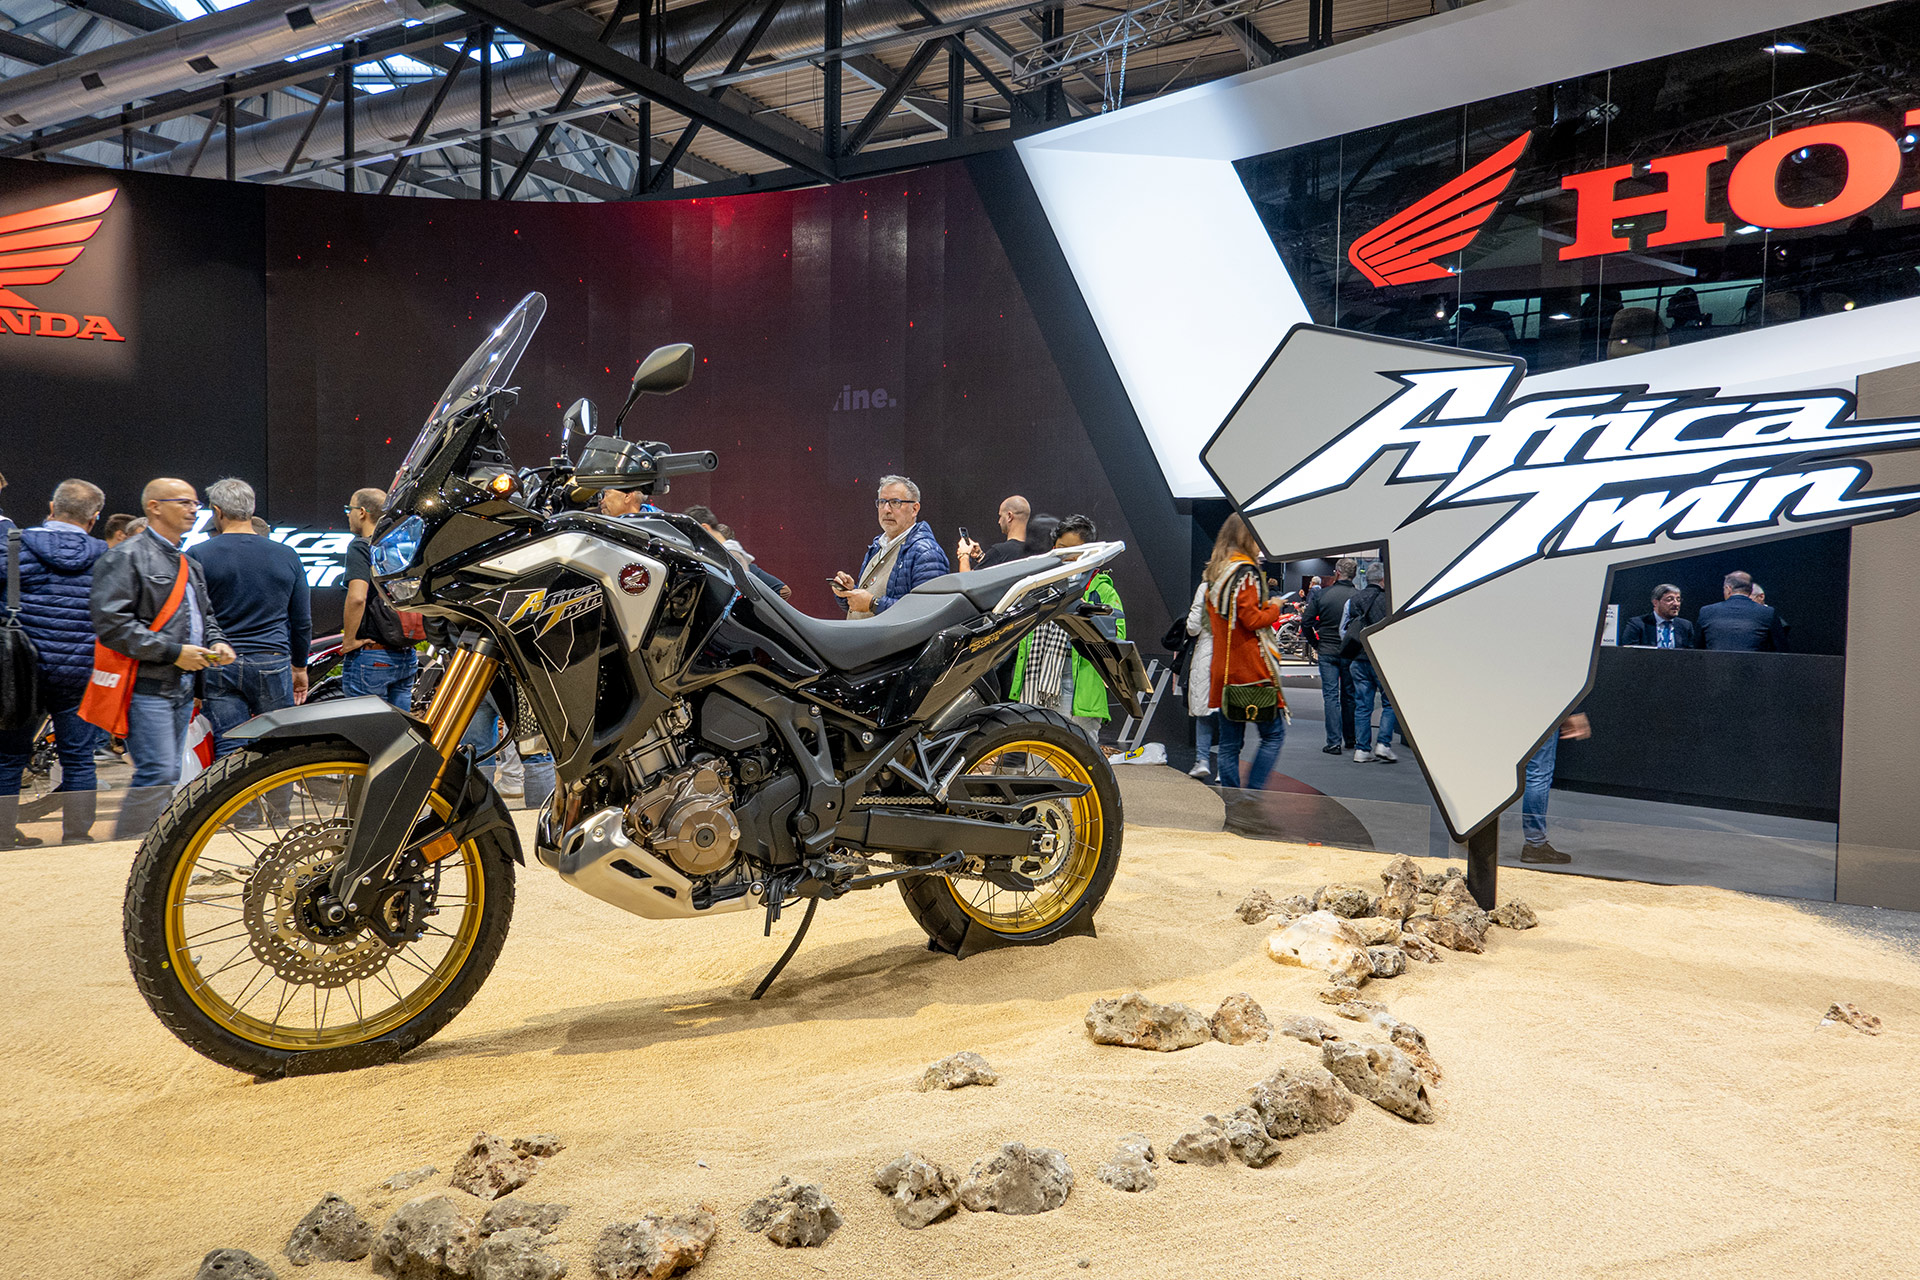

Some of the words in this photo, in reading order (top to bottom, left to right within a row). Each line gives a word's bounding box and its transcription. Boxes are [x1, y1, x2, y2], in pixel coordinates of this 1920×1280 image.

[1559, 107, 1920, 261] HO
[1243, 365, 1920, 513] Africa
[1406, 433, 1920, 611] Twin
[506, 583, 602, 627] Africa
[539, 590, 603, 638] Twin
